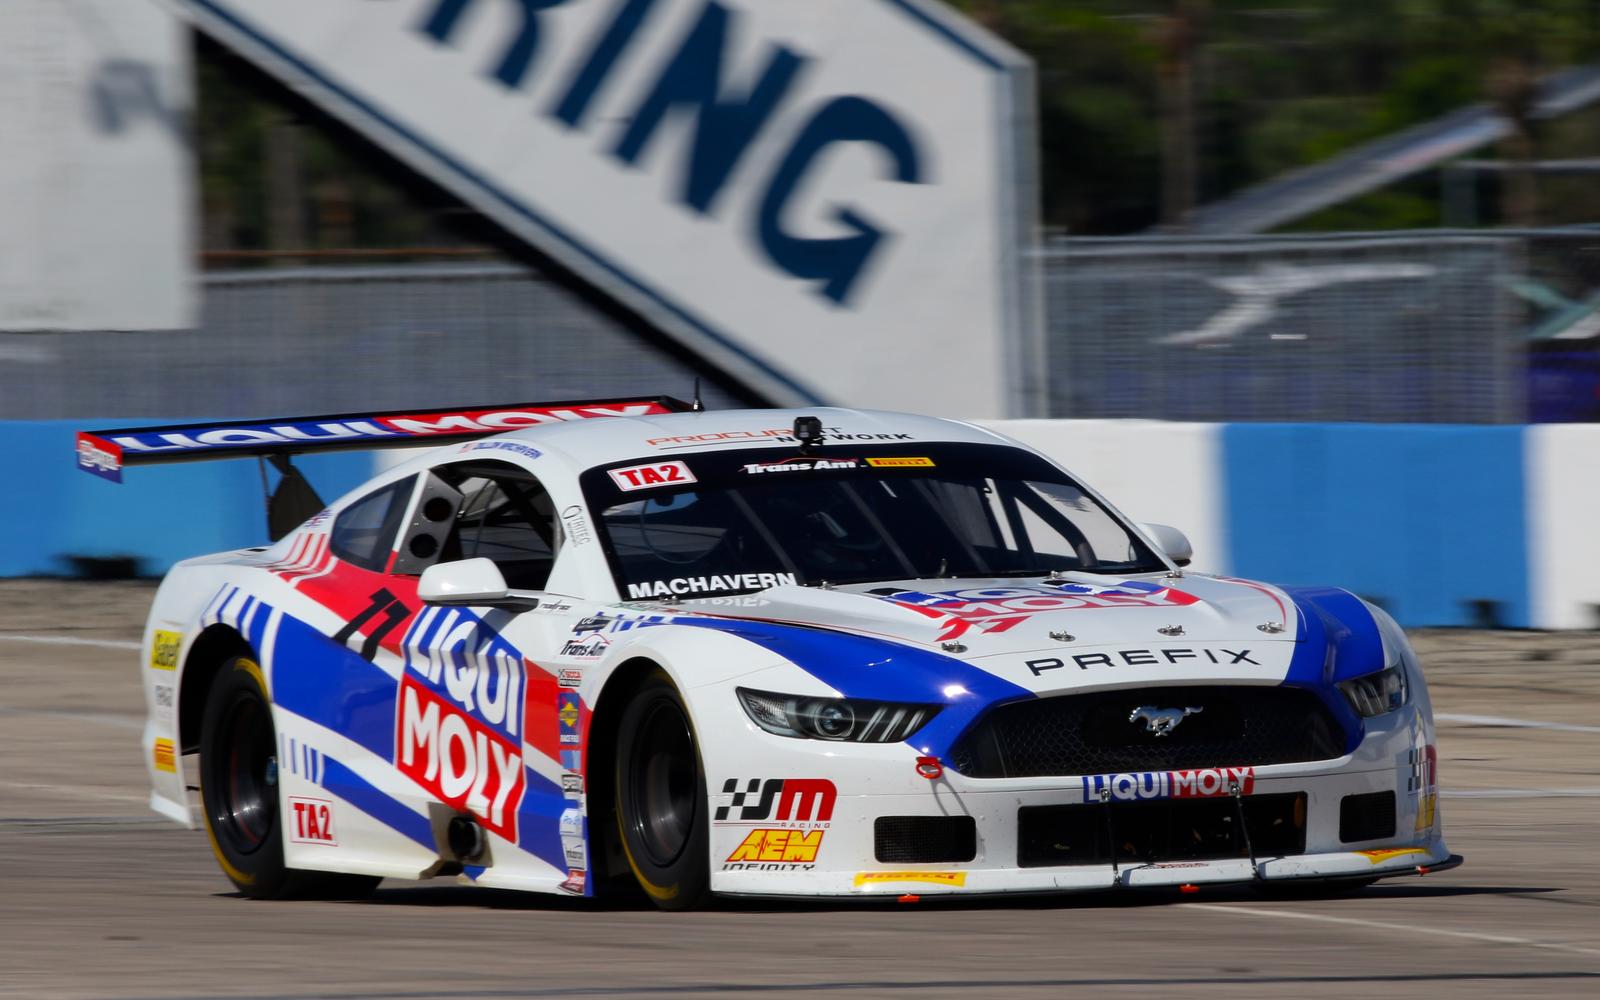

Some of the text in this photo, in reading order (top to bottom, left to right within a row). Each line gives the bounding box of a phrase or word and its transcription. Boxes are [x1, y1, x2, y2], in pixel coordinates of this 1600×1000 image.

[112, 420, 396, 450] LIQUI
[646, 429, 795, 446] PROCUR
[776, 433, 914, 443] NWORK
[744, 460, 856, 474] Trans Am
[872, 458, 928, 466] PIRELLI
[619, 465, 686, 488] TA2
[627, 572, 798, 599] MACHAVERN
[560, 639, 607, 656] Trans Am
[407, 605, 521, 737] LIQUI
[1025, 649, 1262, 677] PREFIX
[402, 685, 521, 828] MOLY
[1088, 767, 1253, 801] LIQUI MOLY
[293, 802, 333, 841] TA2
[725, 829, 825, 862] AEM
[722, 863, 816, 871] INFINITY
